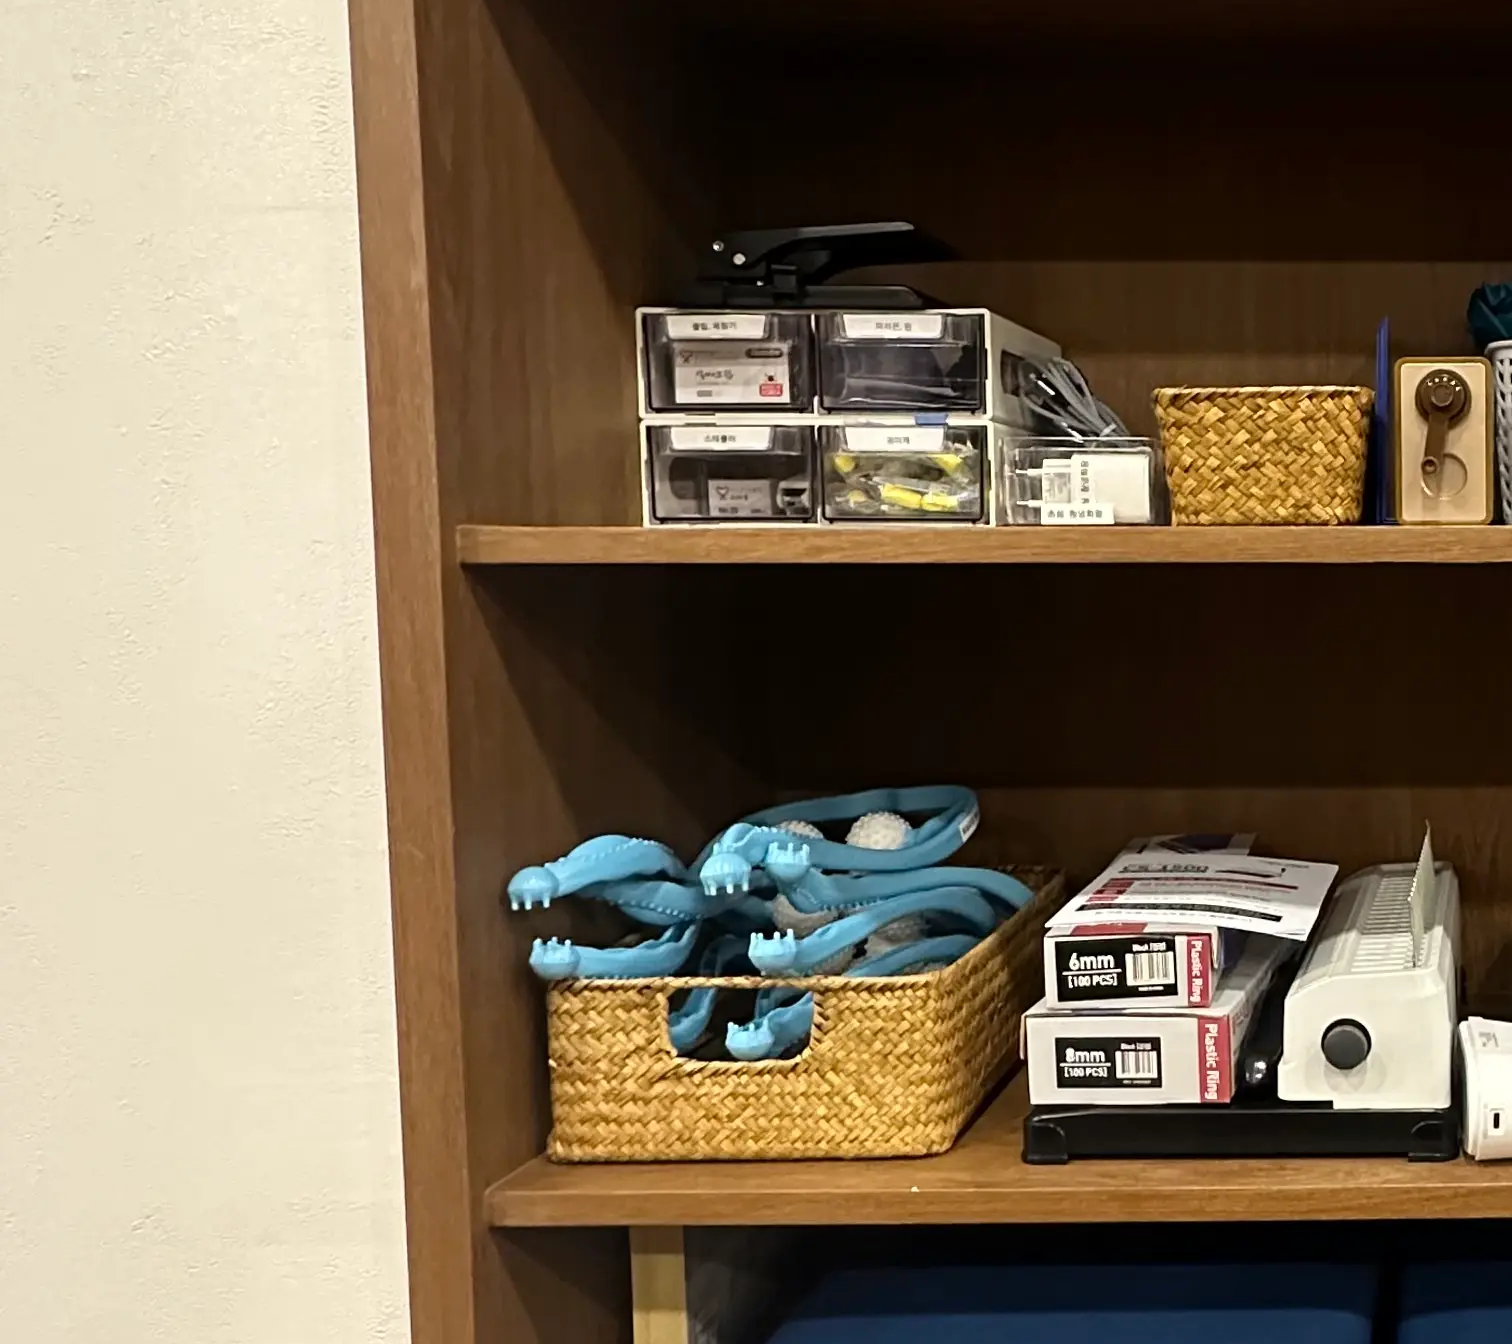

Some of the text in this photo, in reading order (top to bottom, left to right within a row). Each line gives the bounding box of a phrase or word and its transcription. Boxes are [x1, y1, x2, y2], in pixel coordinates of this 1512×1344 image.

[1068, 952, 1115, 971] 6mm
[1067, 973, 1118, 988] [100 PCS]
[1189, 940, 1203, 1003] Plastic Ring
[1065, 1047, 1106, 1063] 8mm
[1204, 1023, 1220, 1100] Plastic Ring
